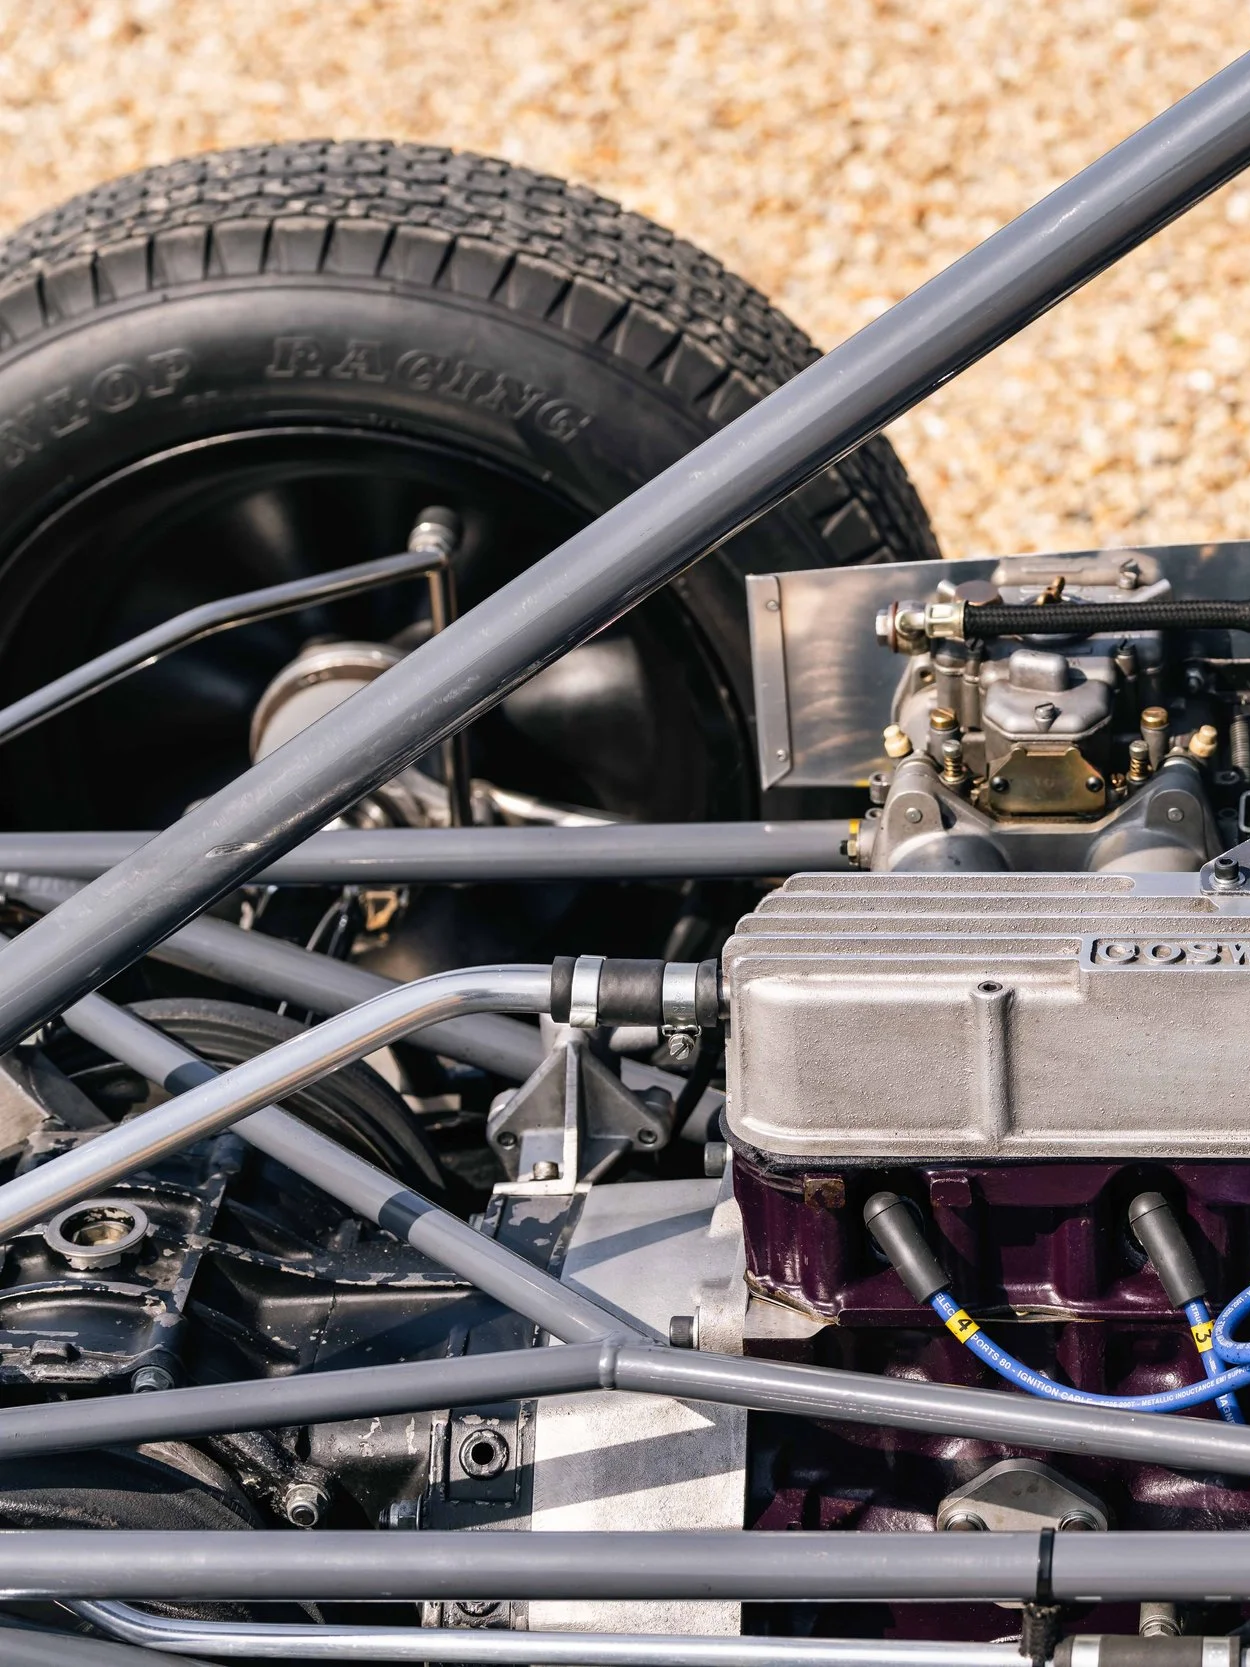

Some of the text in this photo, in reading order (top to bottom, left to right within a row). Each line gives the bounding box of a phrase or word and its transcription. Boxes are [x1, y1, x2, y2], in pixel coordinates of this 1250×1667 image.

[265, 335, 597, 446] RACING
[957, 1318, 973, 1333] 4
[1195, 1328, 1212, 1344] 3
[999, 1358, 1012, 1370] 80
[1017, 1369, 1060, 1398] IGNITION
[1141, 1394, 1174, 1407] METALLIC
[1175, 1380, 1215, 1400] INDUCTANCE
